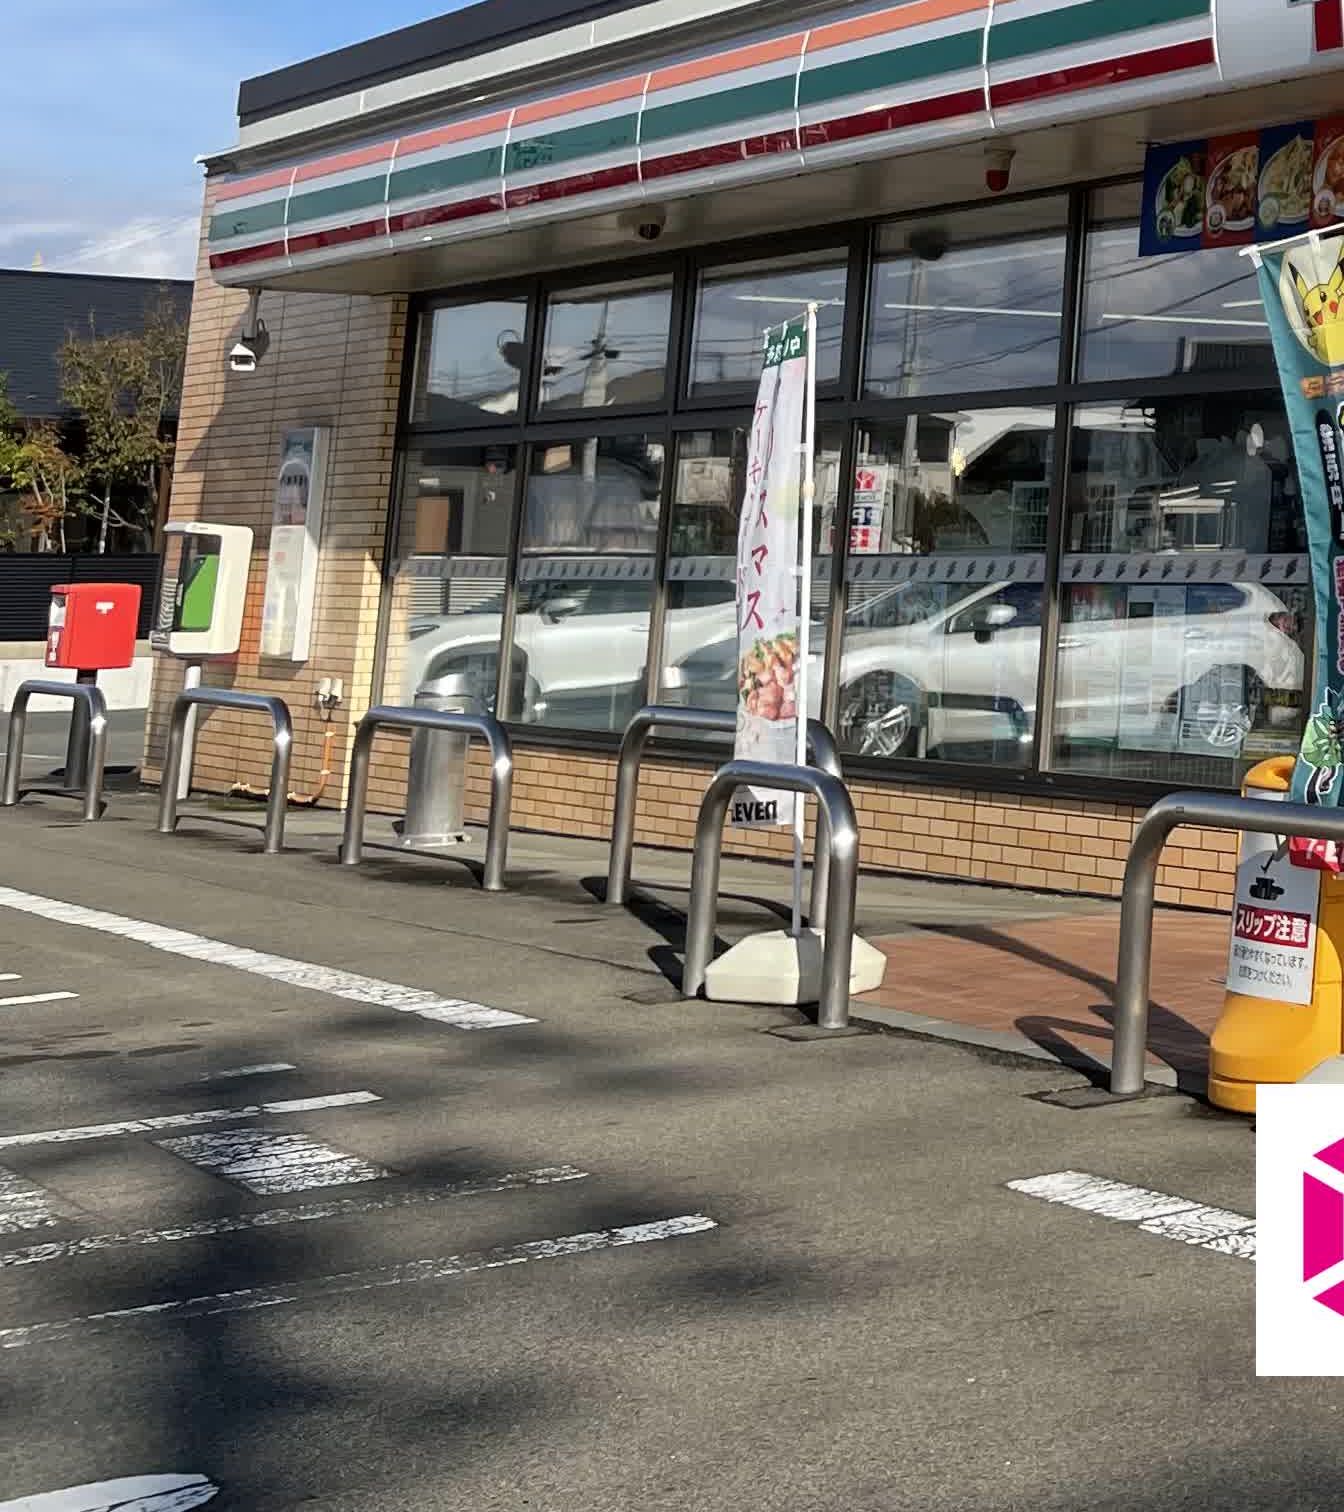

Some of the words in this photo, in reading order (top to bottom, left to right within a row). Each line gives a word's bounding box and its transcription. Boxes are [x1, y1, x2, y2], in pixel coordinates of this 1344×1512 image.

[1236, 908, 1308, 943] スリップ注意
